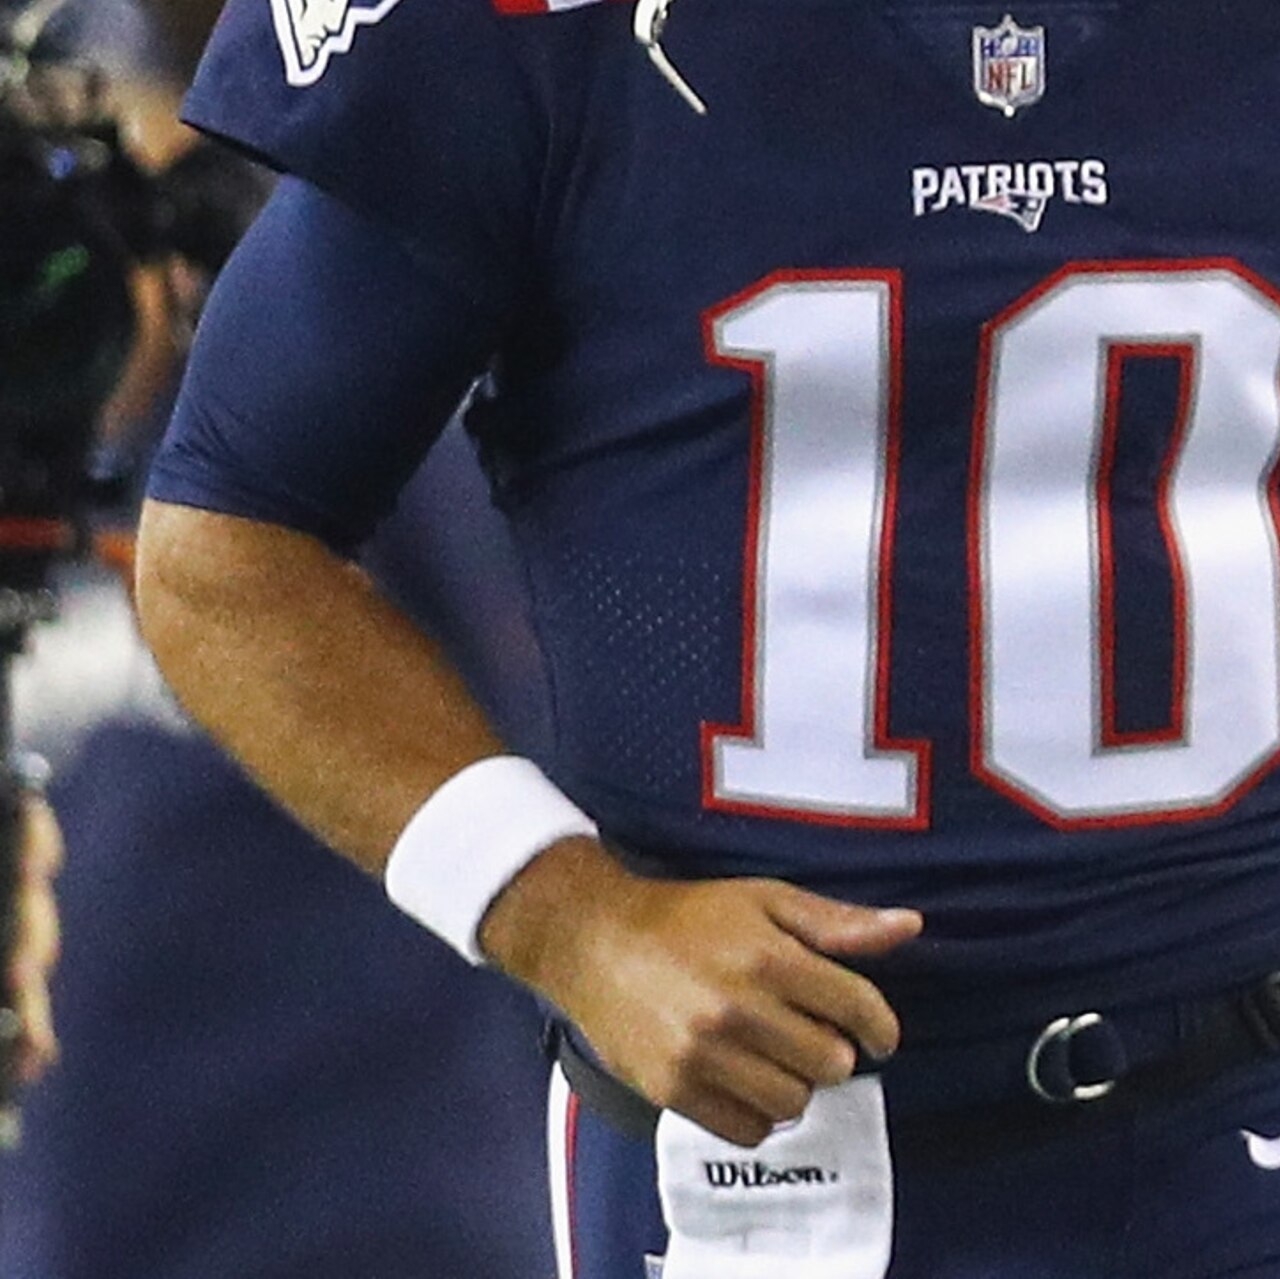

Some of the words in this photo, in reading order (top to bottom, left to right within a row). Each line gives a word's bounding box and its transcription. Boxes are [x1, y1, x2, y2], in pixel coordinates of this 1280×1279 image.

[987, 60, 1033, 95] NFL
[912, 160, 1108, 217] PATRIOTS
[704, 1160, 827, 1188] Wilson
